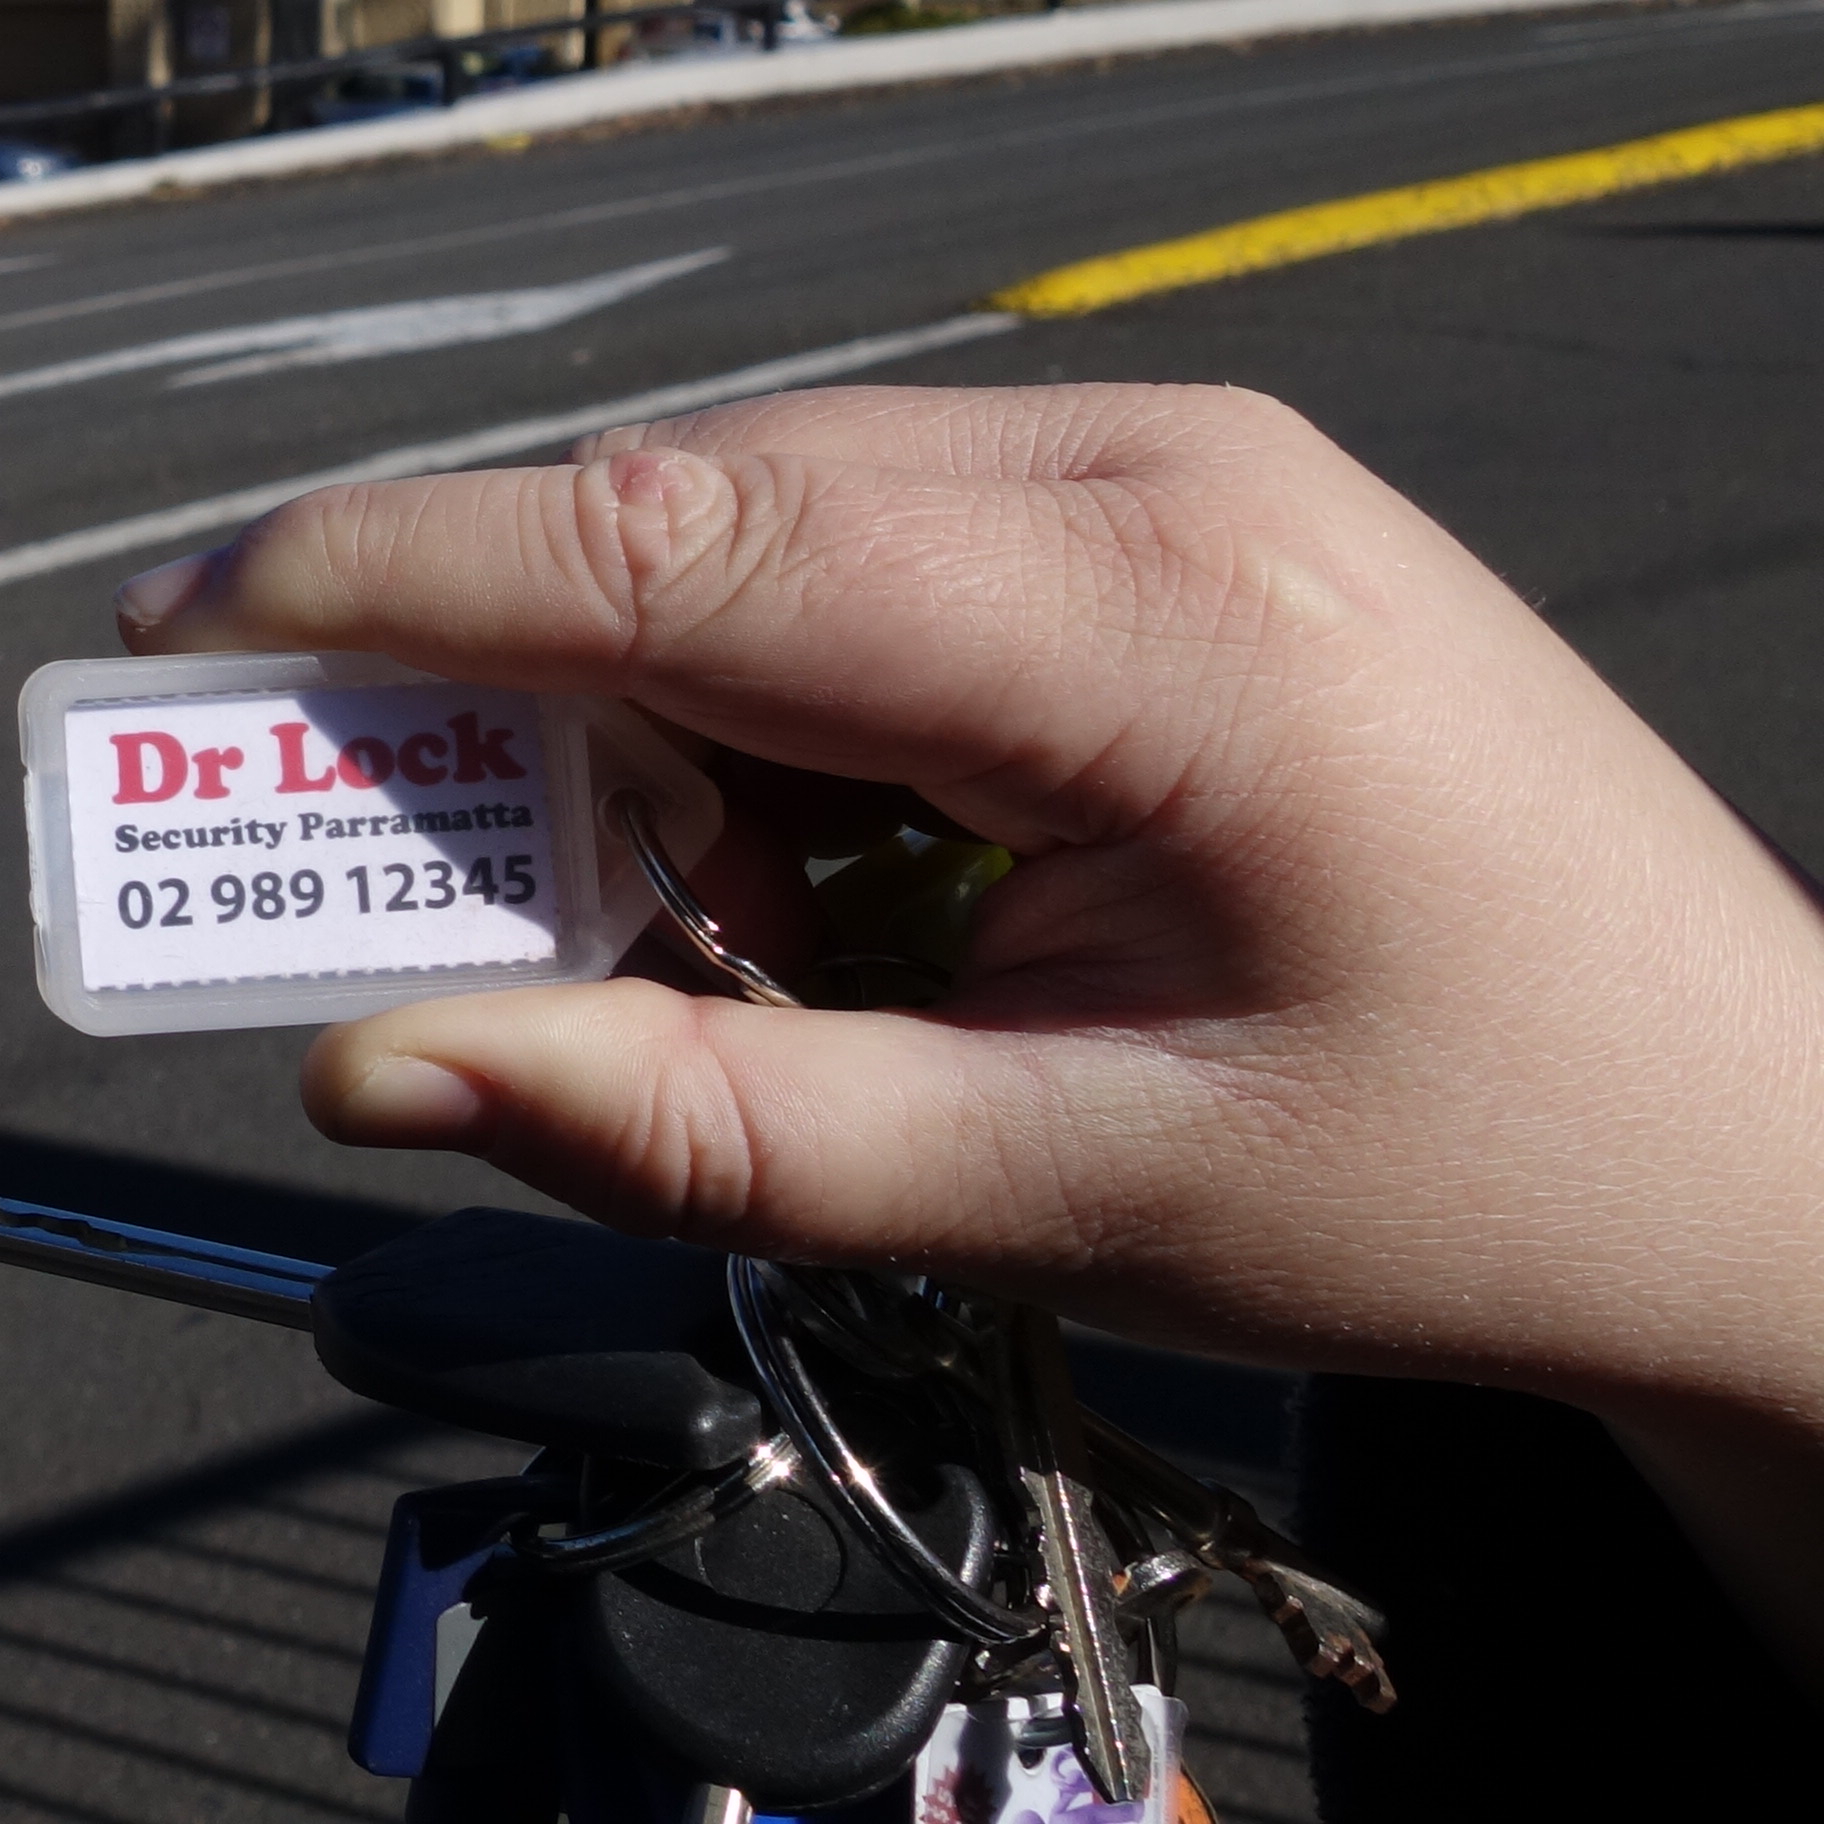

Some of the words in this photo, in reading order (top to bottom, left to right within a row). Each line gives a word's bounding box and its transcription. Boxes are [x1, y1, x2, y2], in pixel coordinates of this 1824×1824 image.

[109, 731, 245, 805] Dr
[269, 711, 527, 794] Lock
[114, 817, 288, 853] Security
[297, 802, 533, 842] Parramatta
[117, 877, 194, 930] 02
[210, 868, 325, 924] 989
[345, 855, 537, 914] 12345
